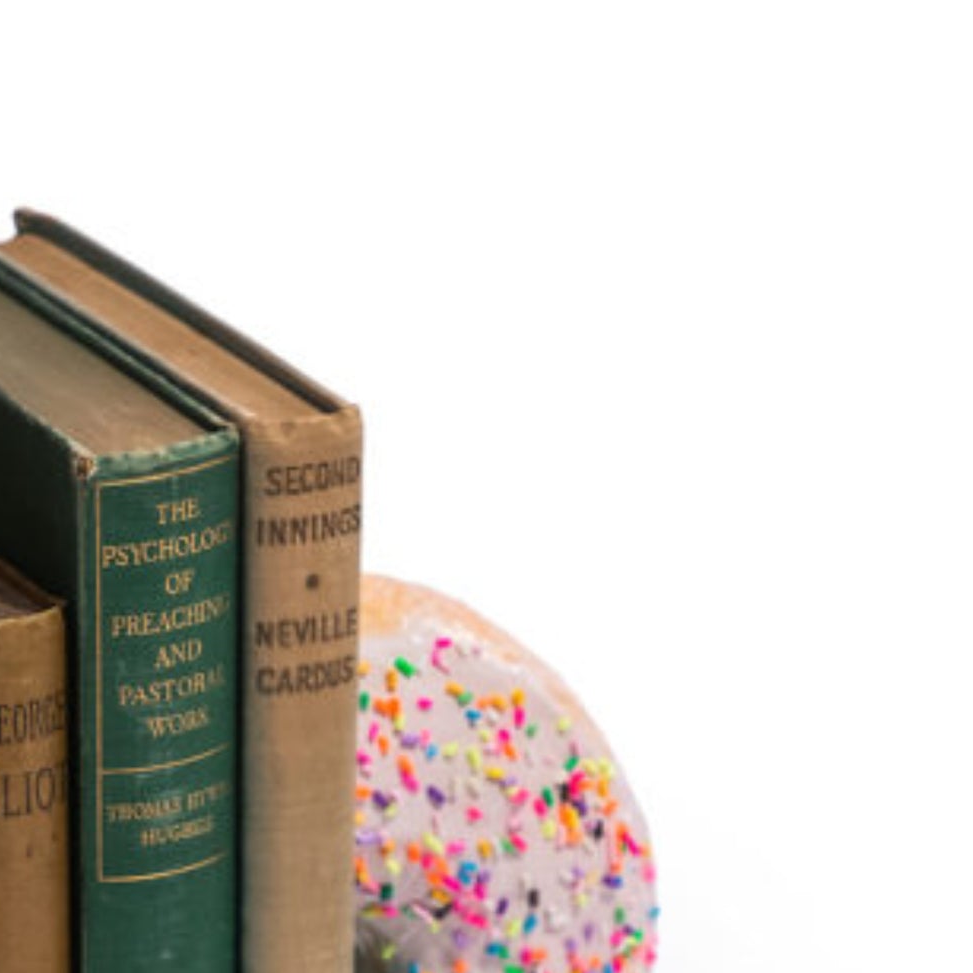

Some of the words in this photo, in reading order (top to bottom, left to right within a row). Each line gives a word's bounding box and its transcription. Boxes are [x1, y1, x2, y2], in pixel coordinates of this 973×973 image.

[265, 457, 361, 496] SECOND
[157, 498, 200, 525] THE
[255, 504, 361, 546] INNINGS
[165, 570, 195, 594] OF
[255, 608, 358, 648] NEVILLE
[154, 637, 202, 668] AND
[255, 656, 356, 695] CARDUS
[146, 705, 208, 737] WORK
